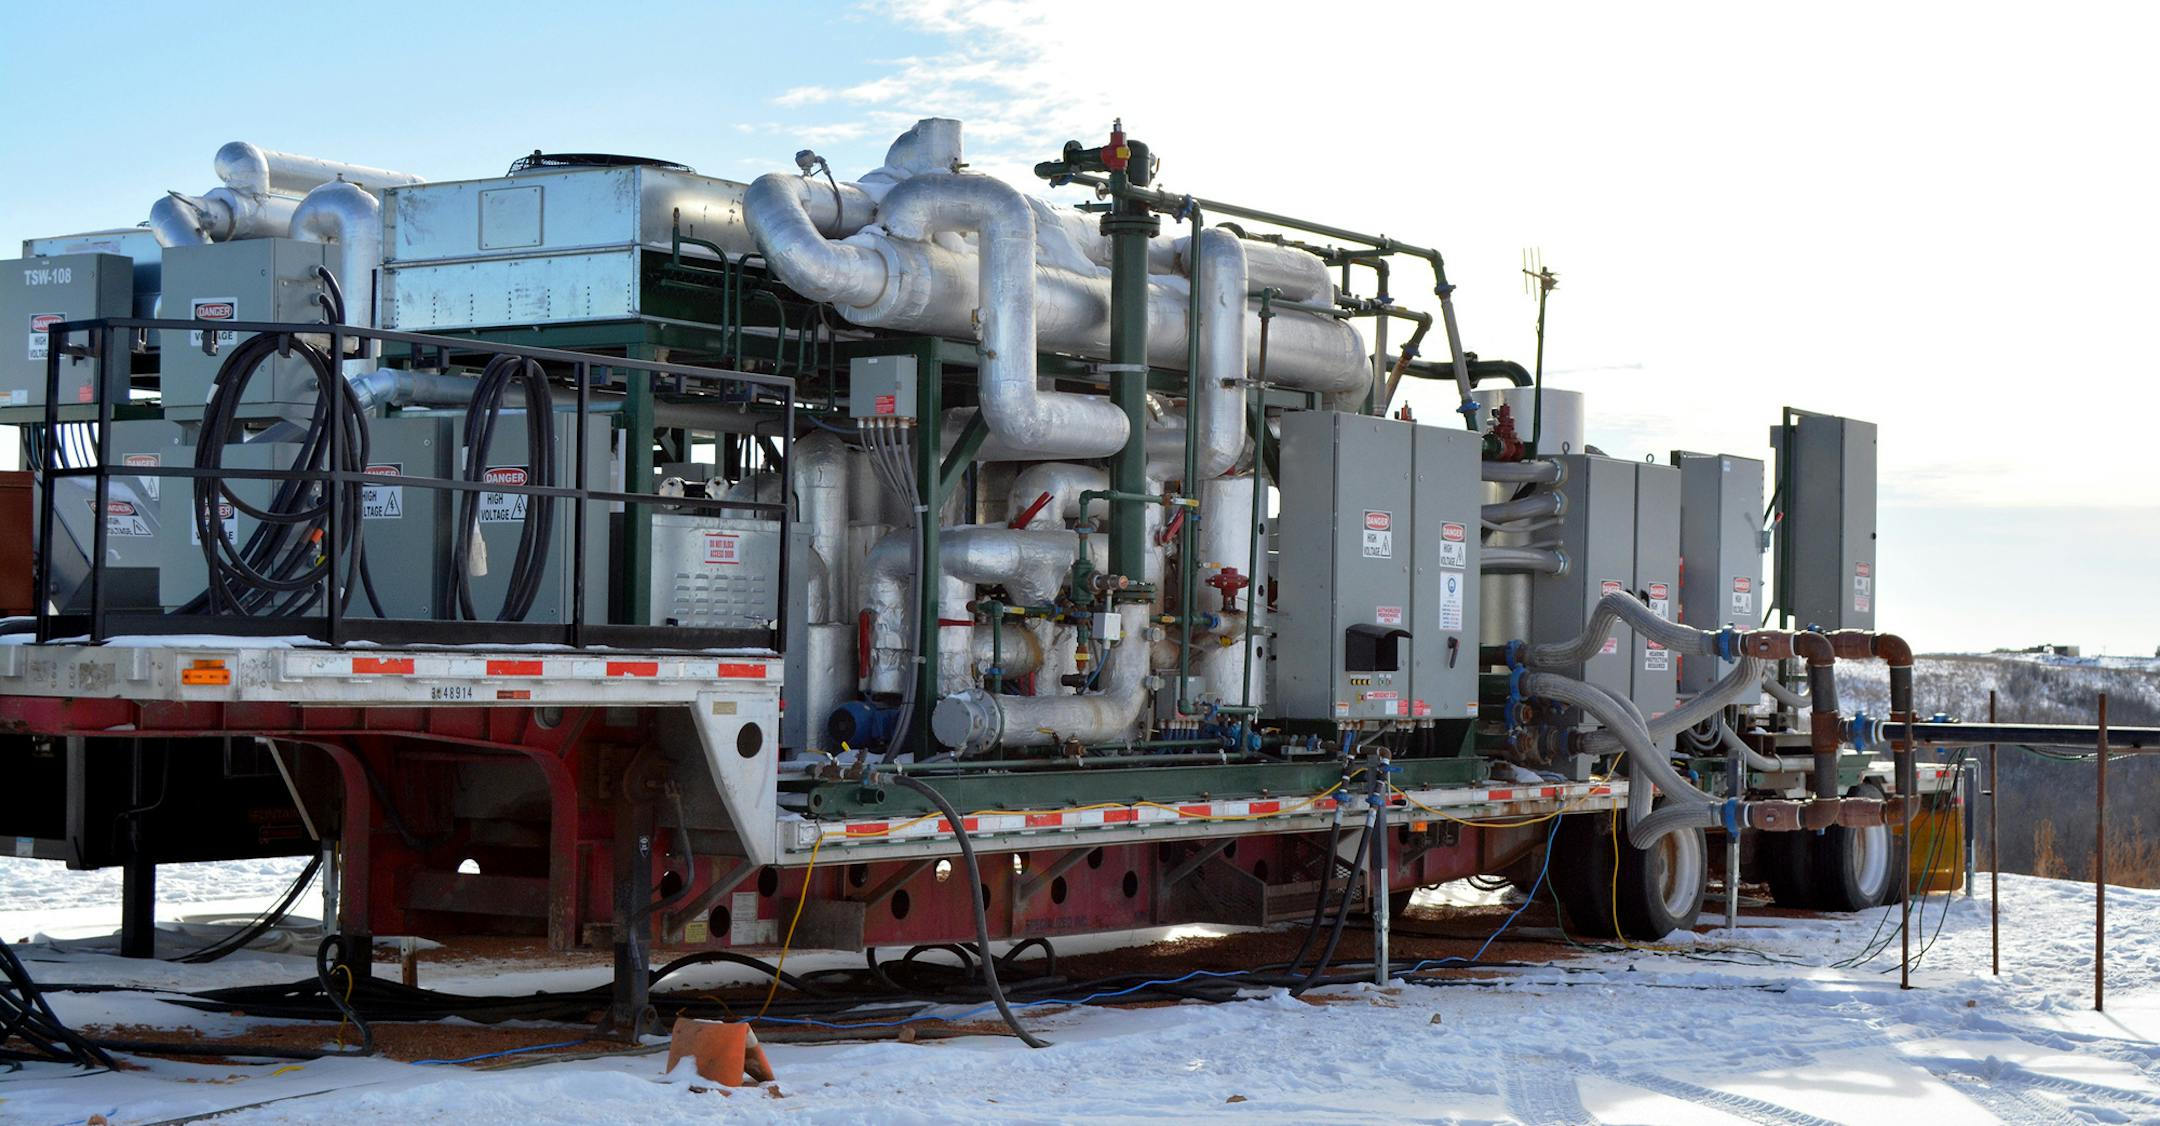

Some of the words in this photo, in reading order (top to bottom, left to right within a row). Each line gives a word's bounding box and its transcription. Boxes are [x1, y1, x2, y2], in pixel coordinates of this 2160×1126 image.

[24, 268, 72, 286] TSW-108
[199, 305, 230, 316] DANGER
[486, 472, 524, 483] DANGER
[487, 493, 503, 505] HIGH
[363, 506, 382, 517] LTAGE
[481, 509, 509, 521] VOLTAGE
[1366, 516, 1388, 525] DANGER
[1443, 528, 1463, 537] DANGER
[1367, 533, 1377, 543] HIGH
[1364, 546, 1380, 556] VOLTAGE
[1443, 544, 1453, 553] HIGH
[1441, 556, 1456, 566] VOLTAGE
